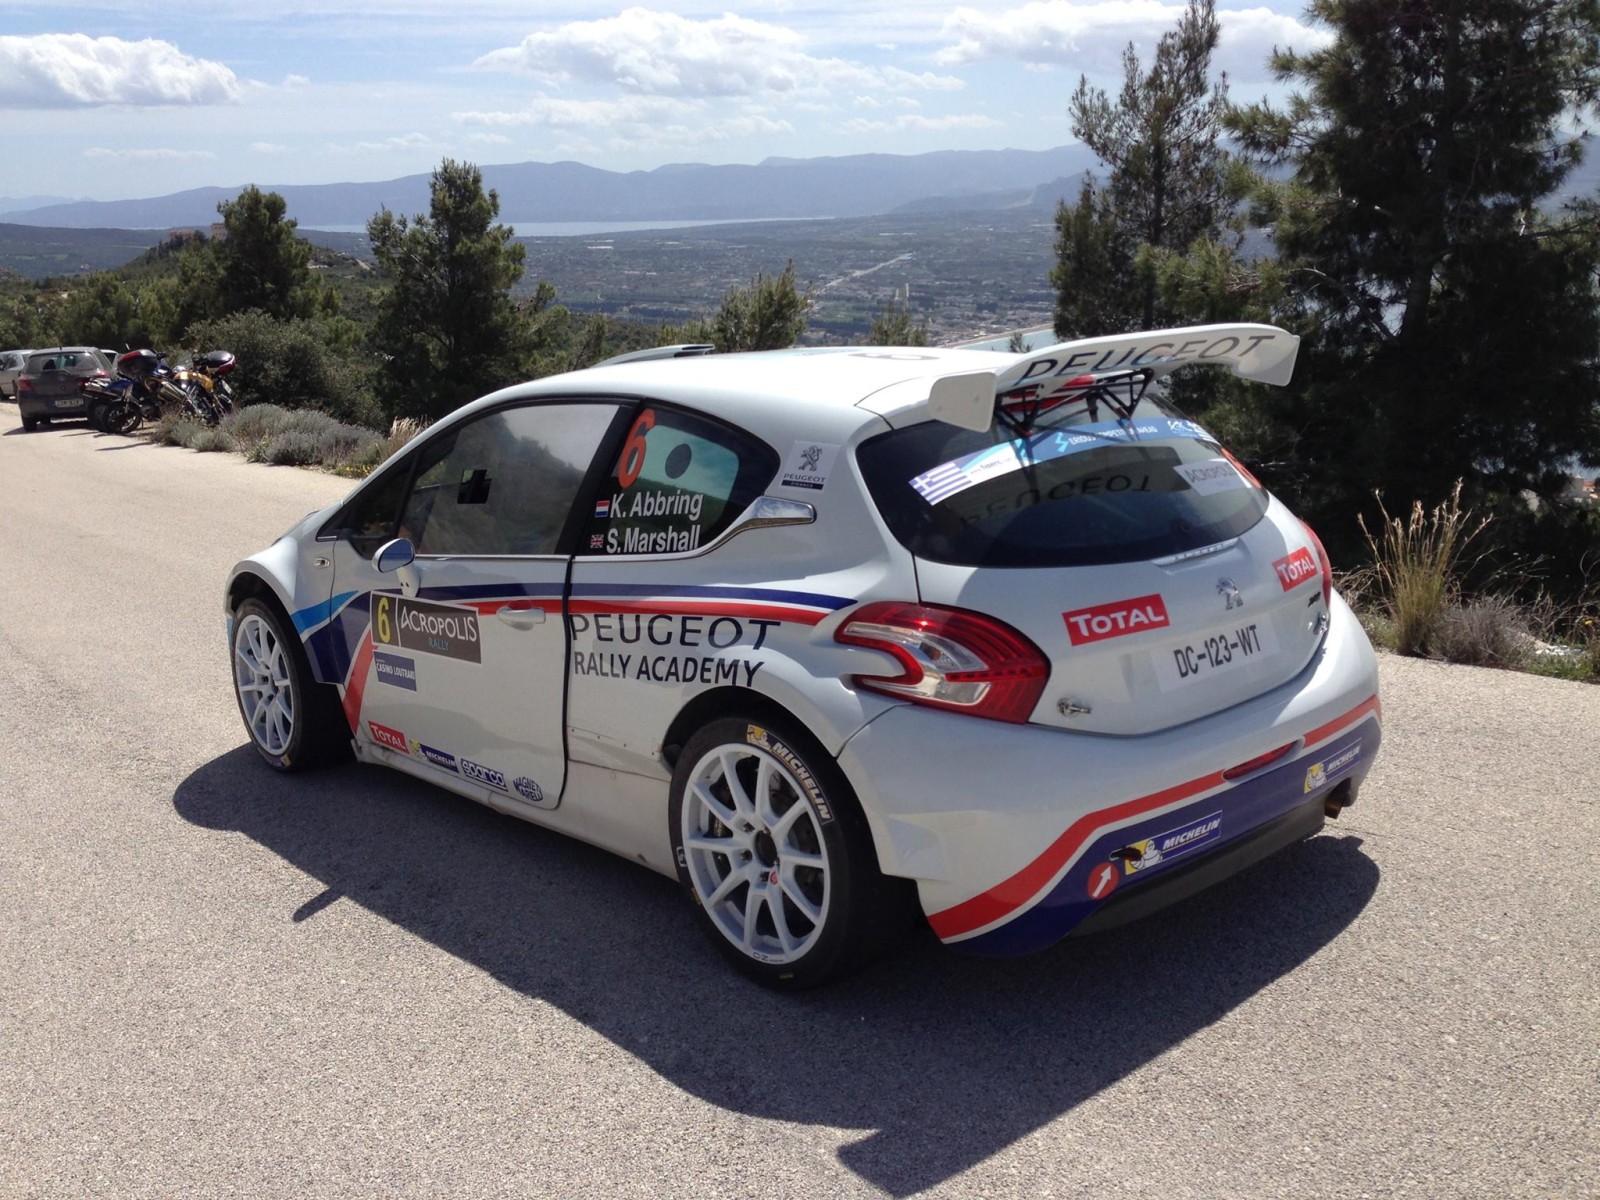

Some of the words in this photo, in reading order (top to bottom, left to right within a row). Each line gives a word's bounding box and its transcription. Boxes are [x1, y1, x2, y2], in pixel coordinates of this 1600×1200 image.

[1014, 334, 1276, 386] PEUGEOT
[617, 408, 655, 490] 6
[783, 473, 826, 483] PEUGEOT
[610, 493, 627, 518] K.
[630, 490, 703, 521] Abbring
[606, 528, 621, 554] S.
[623, 524, 701, 553] Marshall
[1277, 554, 1316, 584] TOTAL
[377, 596, 391, 643] 6
[400, 605, 478, 643] ACROPOLIS
[569, 613, 782, 650] PEUGEOT
[1069, 604, 1165, 638] TOTAL
[428, 637, 449, 651] RALLY
[1173, 624, 1262, 678] DC-123-WT
[376, 662, 393, 675] CASINO
[574, 651, 631, 679] RALLY
[636, 655, 765, 688] ACADEMY
[371, 724, 407, 750] TOTAL
[425, 750, 456, 768] MICHELIN
[462, 760, 505, 786] sparco
[1326, 745, 1361, 771] MICHELIN
[773, 741, 832, 820] MICHELIN
[1162, 818, 1221, 850] MICHELIN
